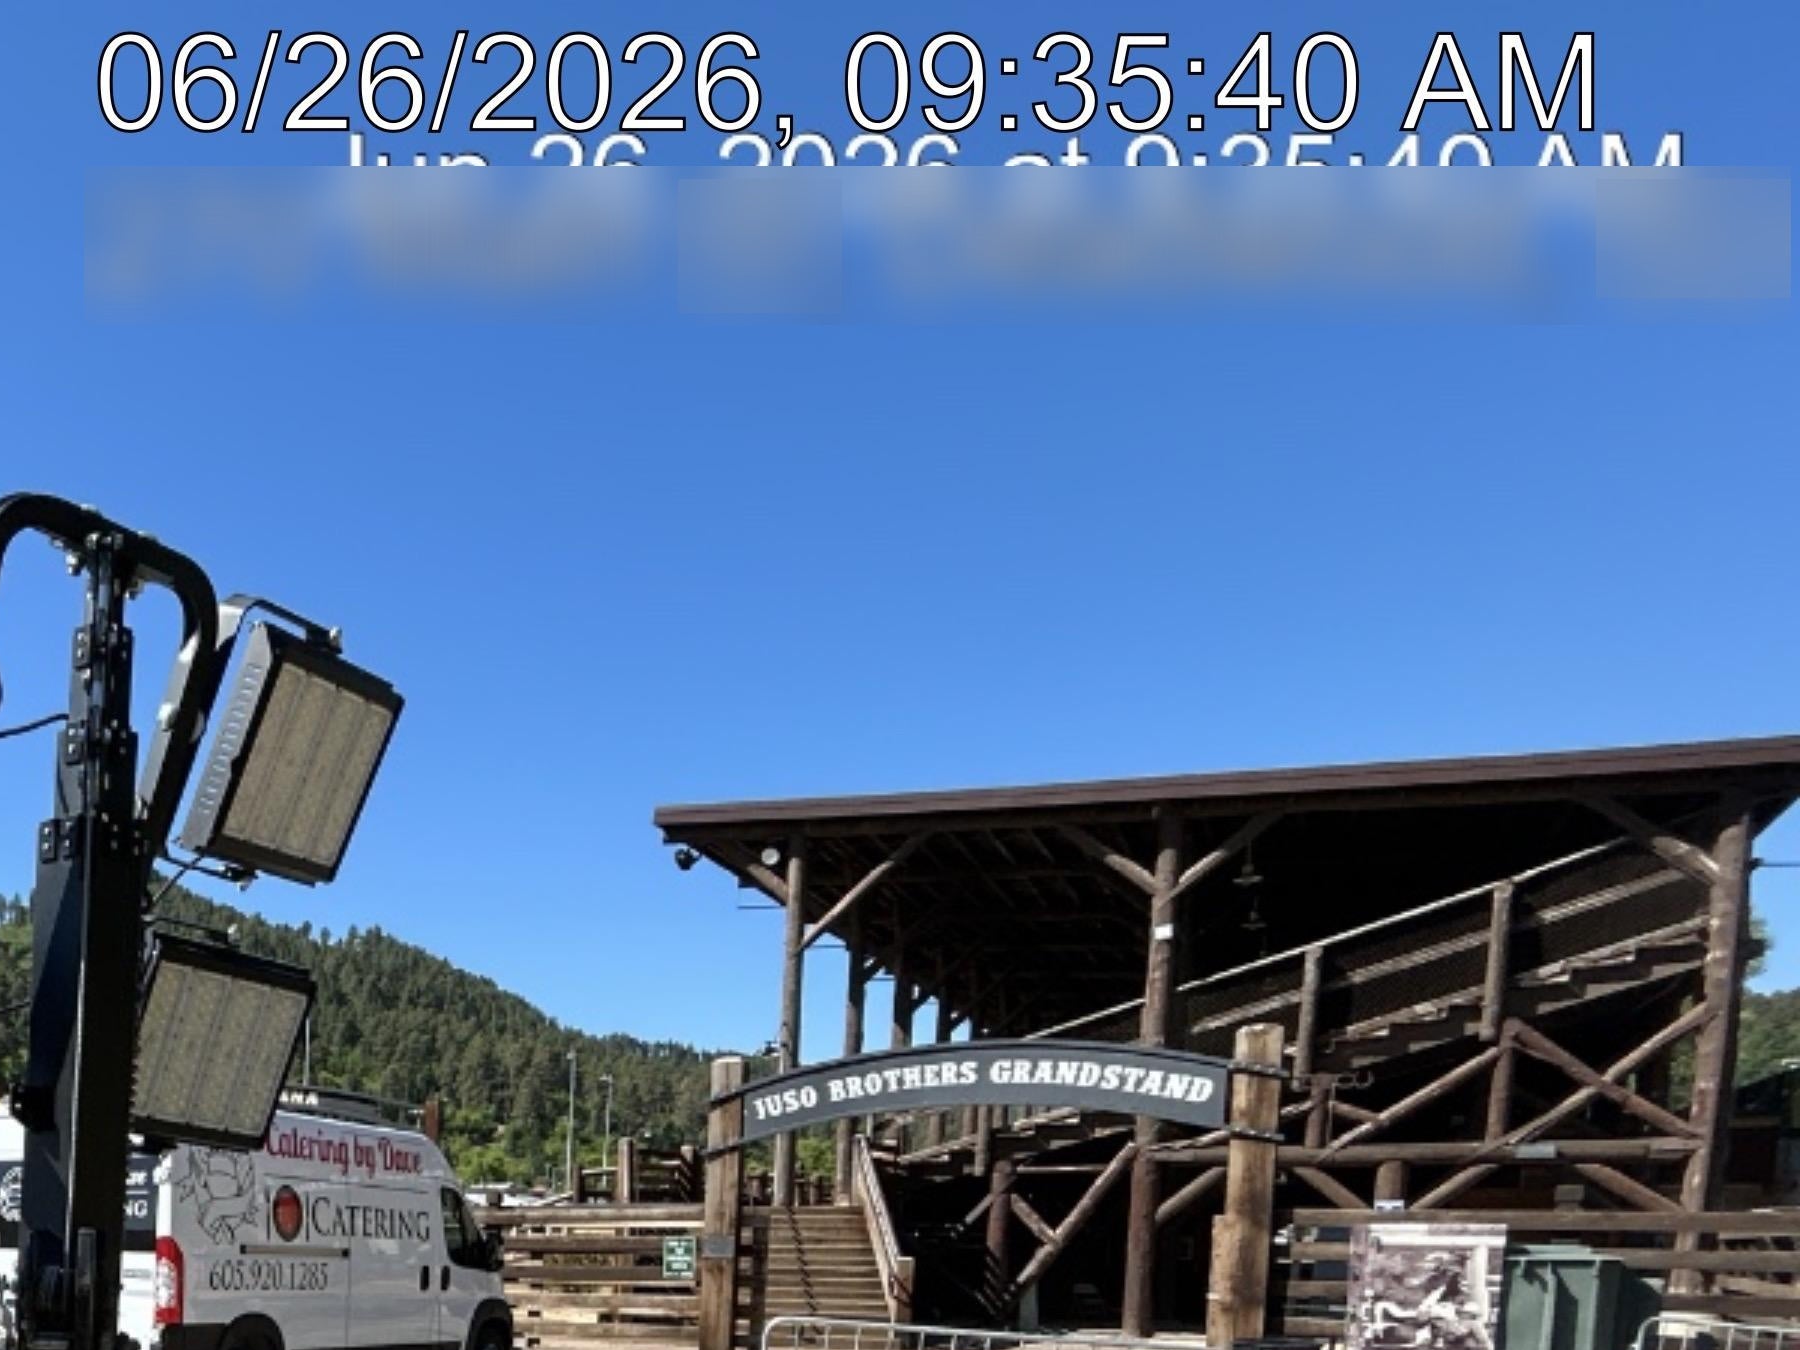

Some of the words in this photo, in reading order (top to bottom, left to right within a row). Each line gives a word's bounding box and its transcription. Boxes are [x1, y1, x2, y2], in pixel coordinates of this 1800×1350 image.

[752, 1085, 817, 1119] JUSO
[829, 1060, 979, 1102] BROTHERS
[989, 1060, 1215, 1103] GRANDSTAND
[264, 1128, 349, 1176] Catering
[354, 1133, 376, 1178] by
[377, 1136, 423, 1174] Dave
[209, 1258, 329, 1291] 605.920.1285
